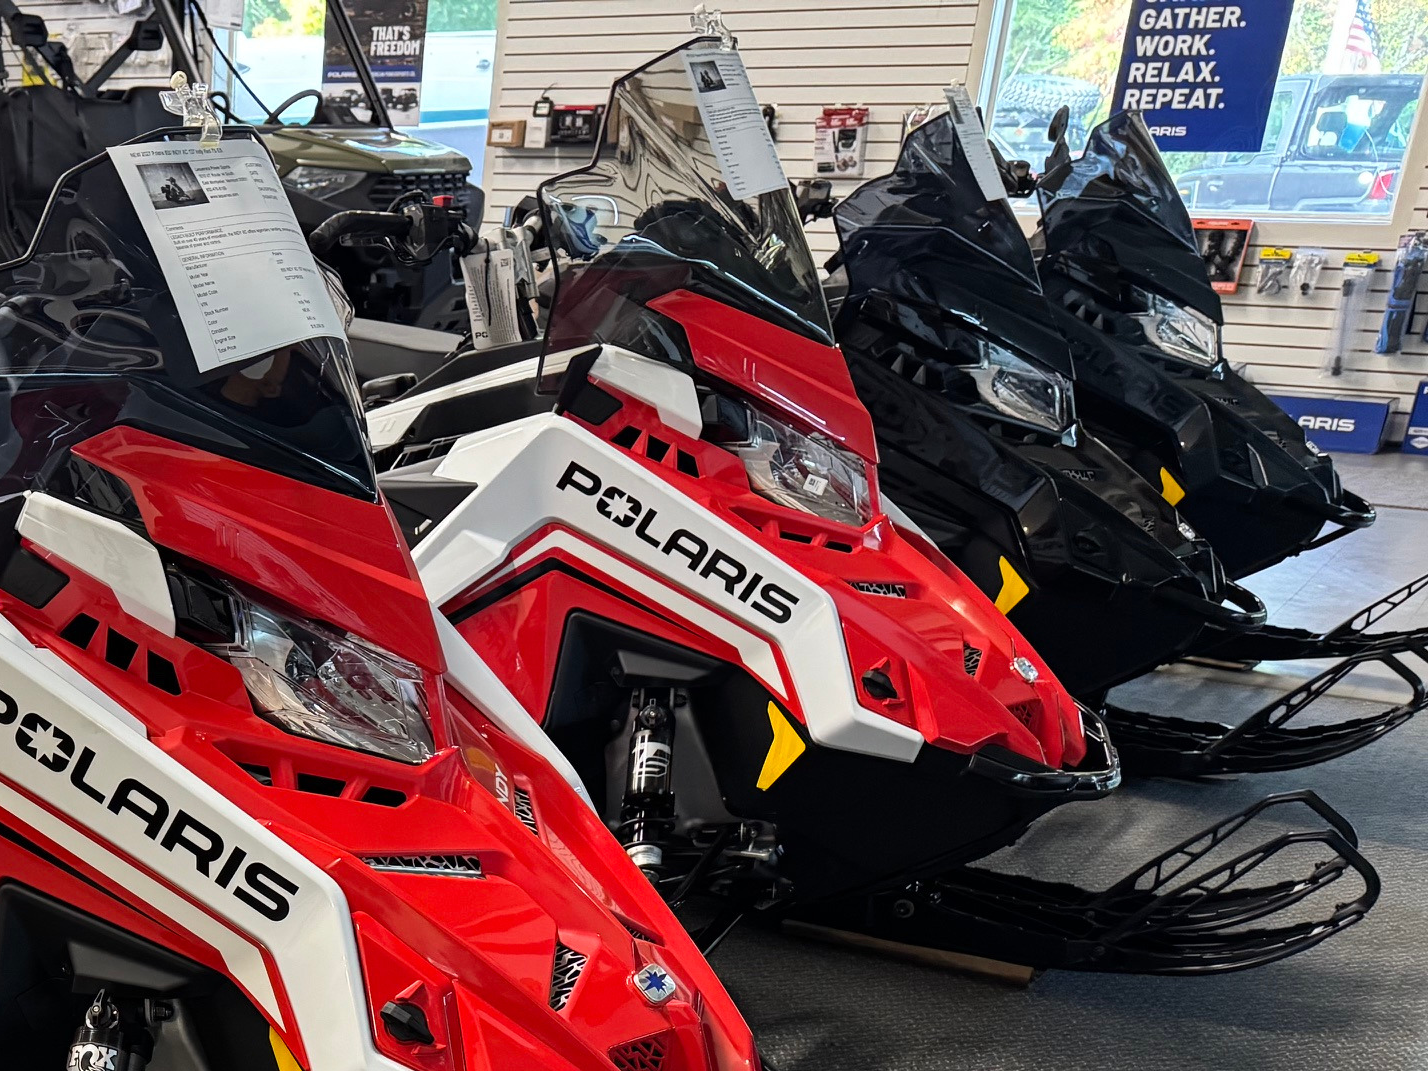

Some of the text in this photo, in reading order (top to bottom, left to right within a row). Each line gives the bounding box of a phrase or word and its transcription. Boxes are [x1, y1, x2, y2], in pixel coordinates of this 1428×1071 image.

[1139, 6, 1247, 30] GATHER.
[371, 26, 411, 40] THAT'S
[370, 40, 420, 56] FREEDOM
[1135, 34, 1216, 57] WORK.
[1127, 61, 1220, 83] RELAX.
[1122, 88, 1225, 110] REPEAT.
[1149, 126, 1187, 137] ARIS
[1297, 415, 1355, 432] ARIS
[555, 460, 800, 624] POLARIS
[494, 762, 509, 803] NDY
